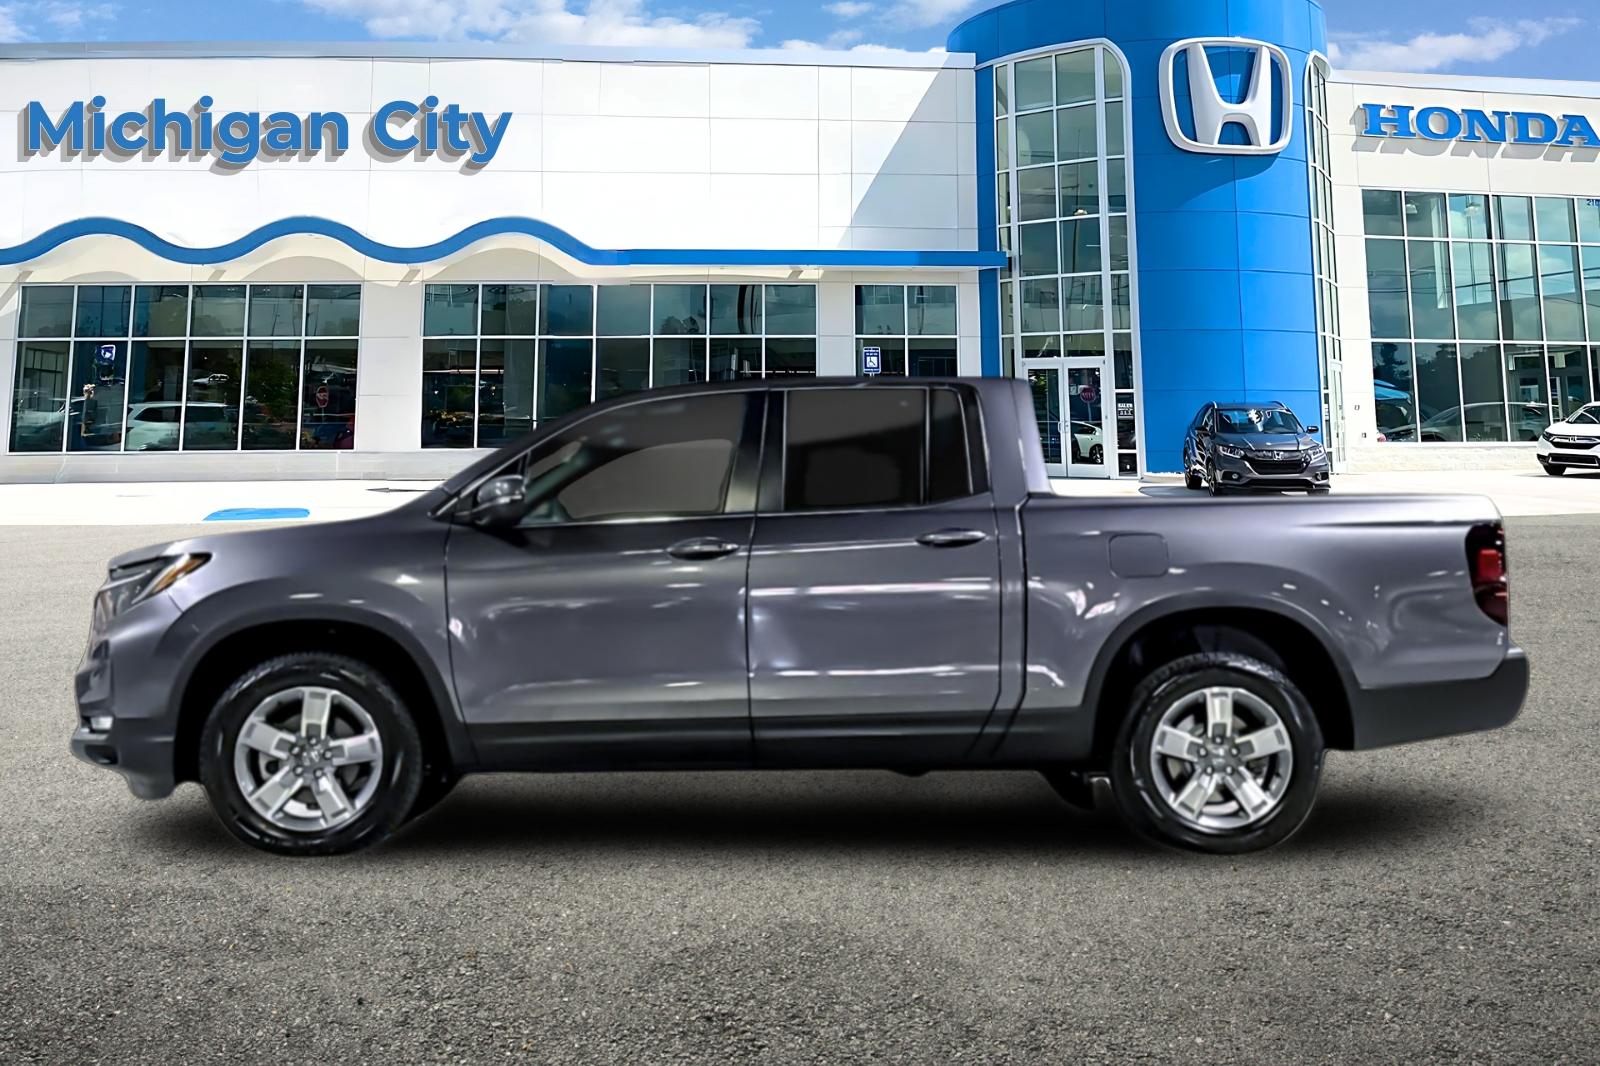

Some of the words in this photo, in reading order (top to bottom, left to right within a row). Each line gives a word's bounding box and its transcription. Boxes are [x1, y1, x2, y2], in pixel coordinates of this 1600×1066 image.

[29, 95, 349, 163] Michigan
[373, 95, 513, 163] City
[1361, 103, 1600, 148] HONDA
